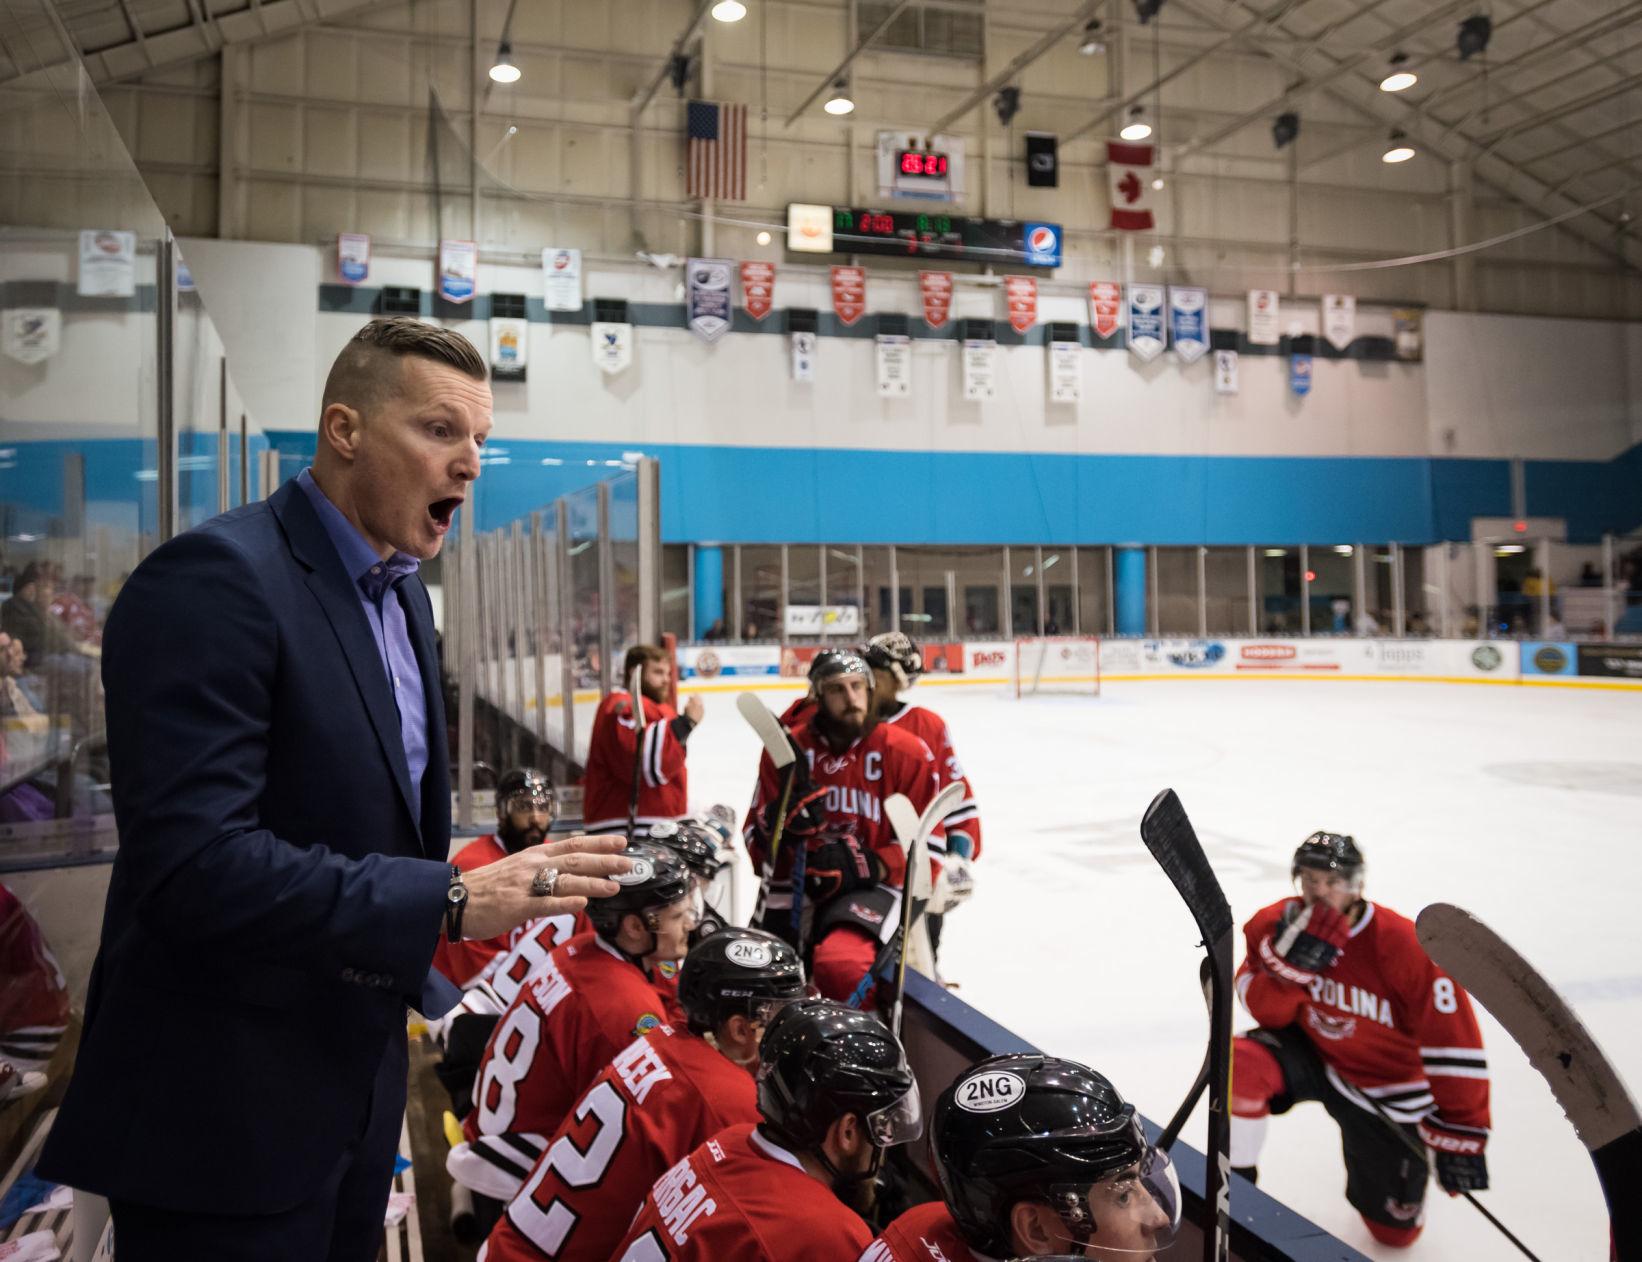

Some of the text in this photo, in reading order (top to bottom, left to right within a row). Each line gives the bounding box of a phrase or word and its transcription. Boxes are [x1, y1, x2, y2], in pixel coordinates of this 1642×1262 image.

[865, 751, 883, 781] C
[825, 786, 882, 823] OLINA
[720, 989, 754, 998] CCM
[1307, 973, 1394, 1029] ROLINA
[1433, 977, 1458, 1014] 8
[478, 1003, 541, 1137] 8
[966, 1076, 1012, 1101] 2NG
[507, 1080, 627, 1258] 2
